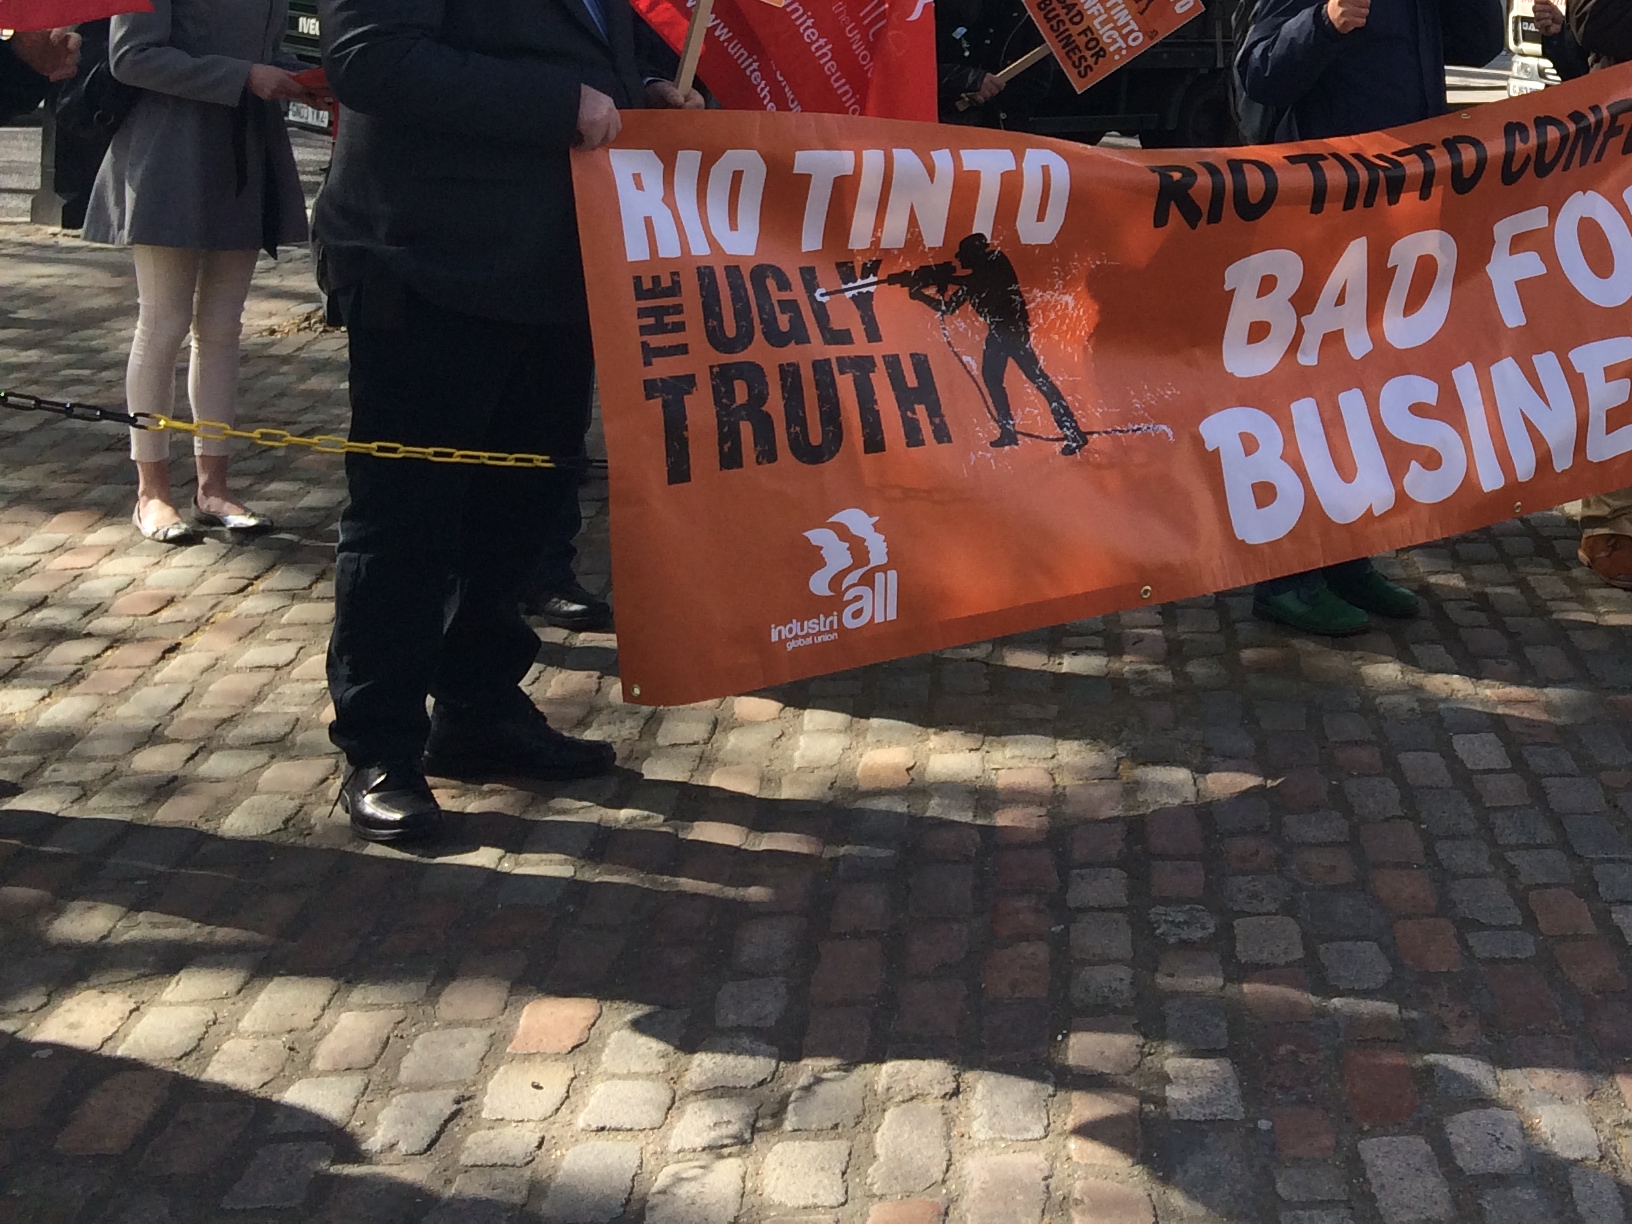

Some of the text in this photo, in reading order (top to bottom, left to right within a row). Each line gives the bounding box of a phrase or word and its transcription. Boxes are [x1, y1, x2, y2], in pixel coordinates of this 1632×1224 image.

[1077, 26, 1107, 66] FOR
[608, 148, 1071, 262] RIO TINTO
[1150, 158, 1280, 231] RIO
[1282, 134, 1489, 215] TINTO
[632, 270, 690, 368] THE
[696, 258, 884, 356] UGLY
[1222, 228, 1458, 378] BAD
[643, 352, 953, 487] TRUTH
[770, 569, 898, 642] industri all
[786, 631, 839, 652] global union
